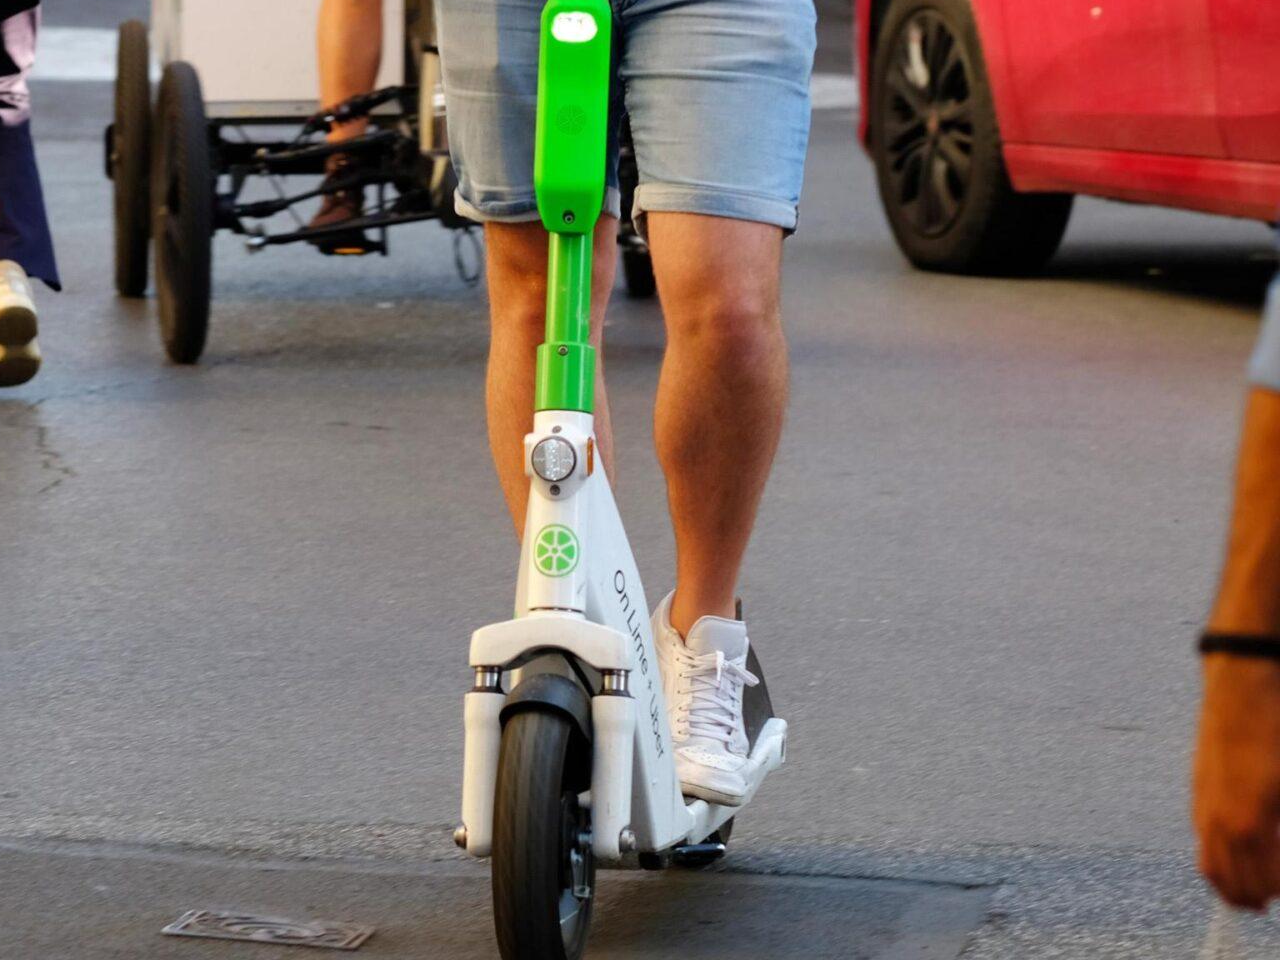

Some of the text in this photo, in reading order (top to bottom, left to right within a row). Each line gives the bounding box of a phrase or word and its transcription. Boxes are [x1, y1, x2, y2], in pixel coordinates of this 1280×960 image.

[613, 569, 630, 612] On
[626, 609, 649, 676] Lime
[648, 692, 665, 759] Uber
